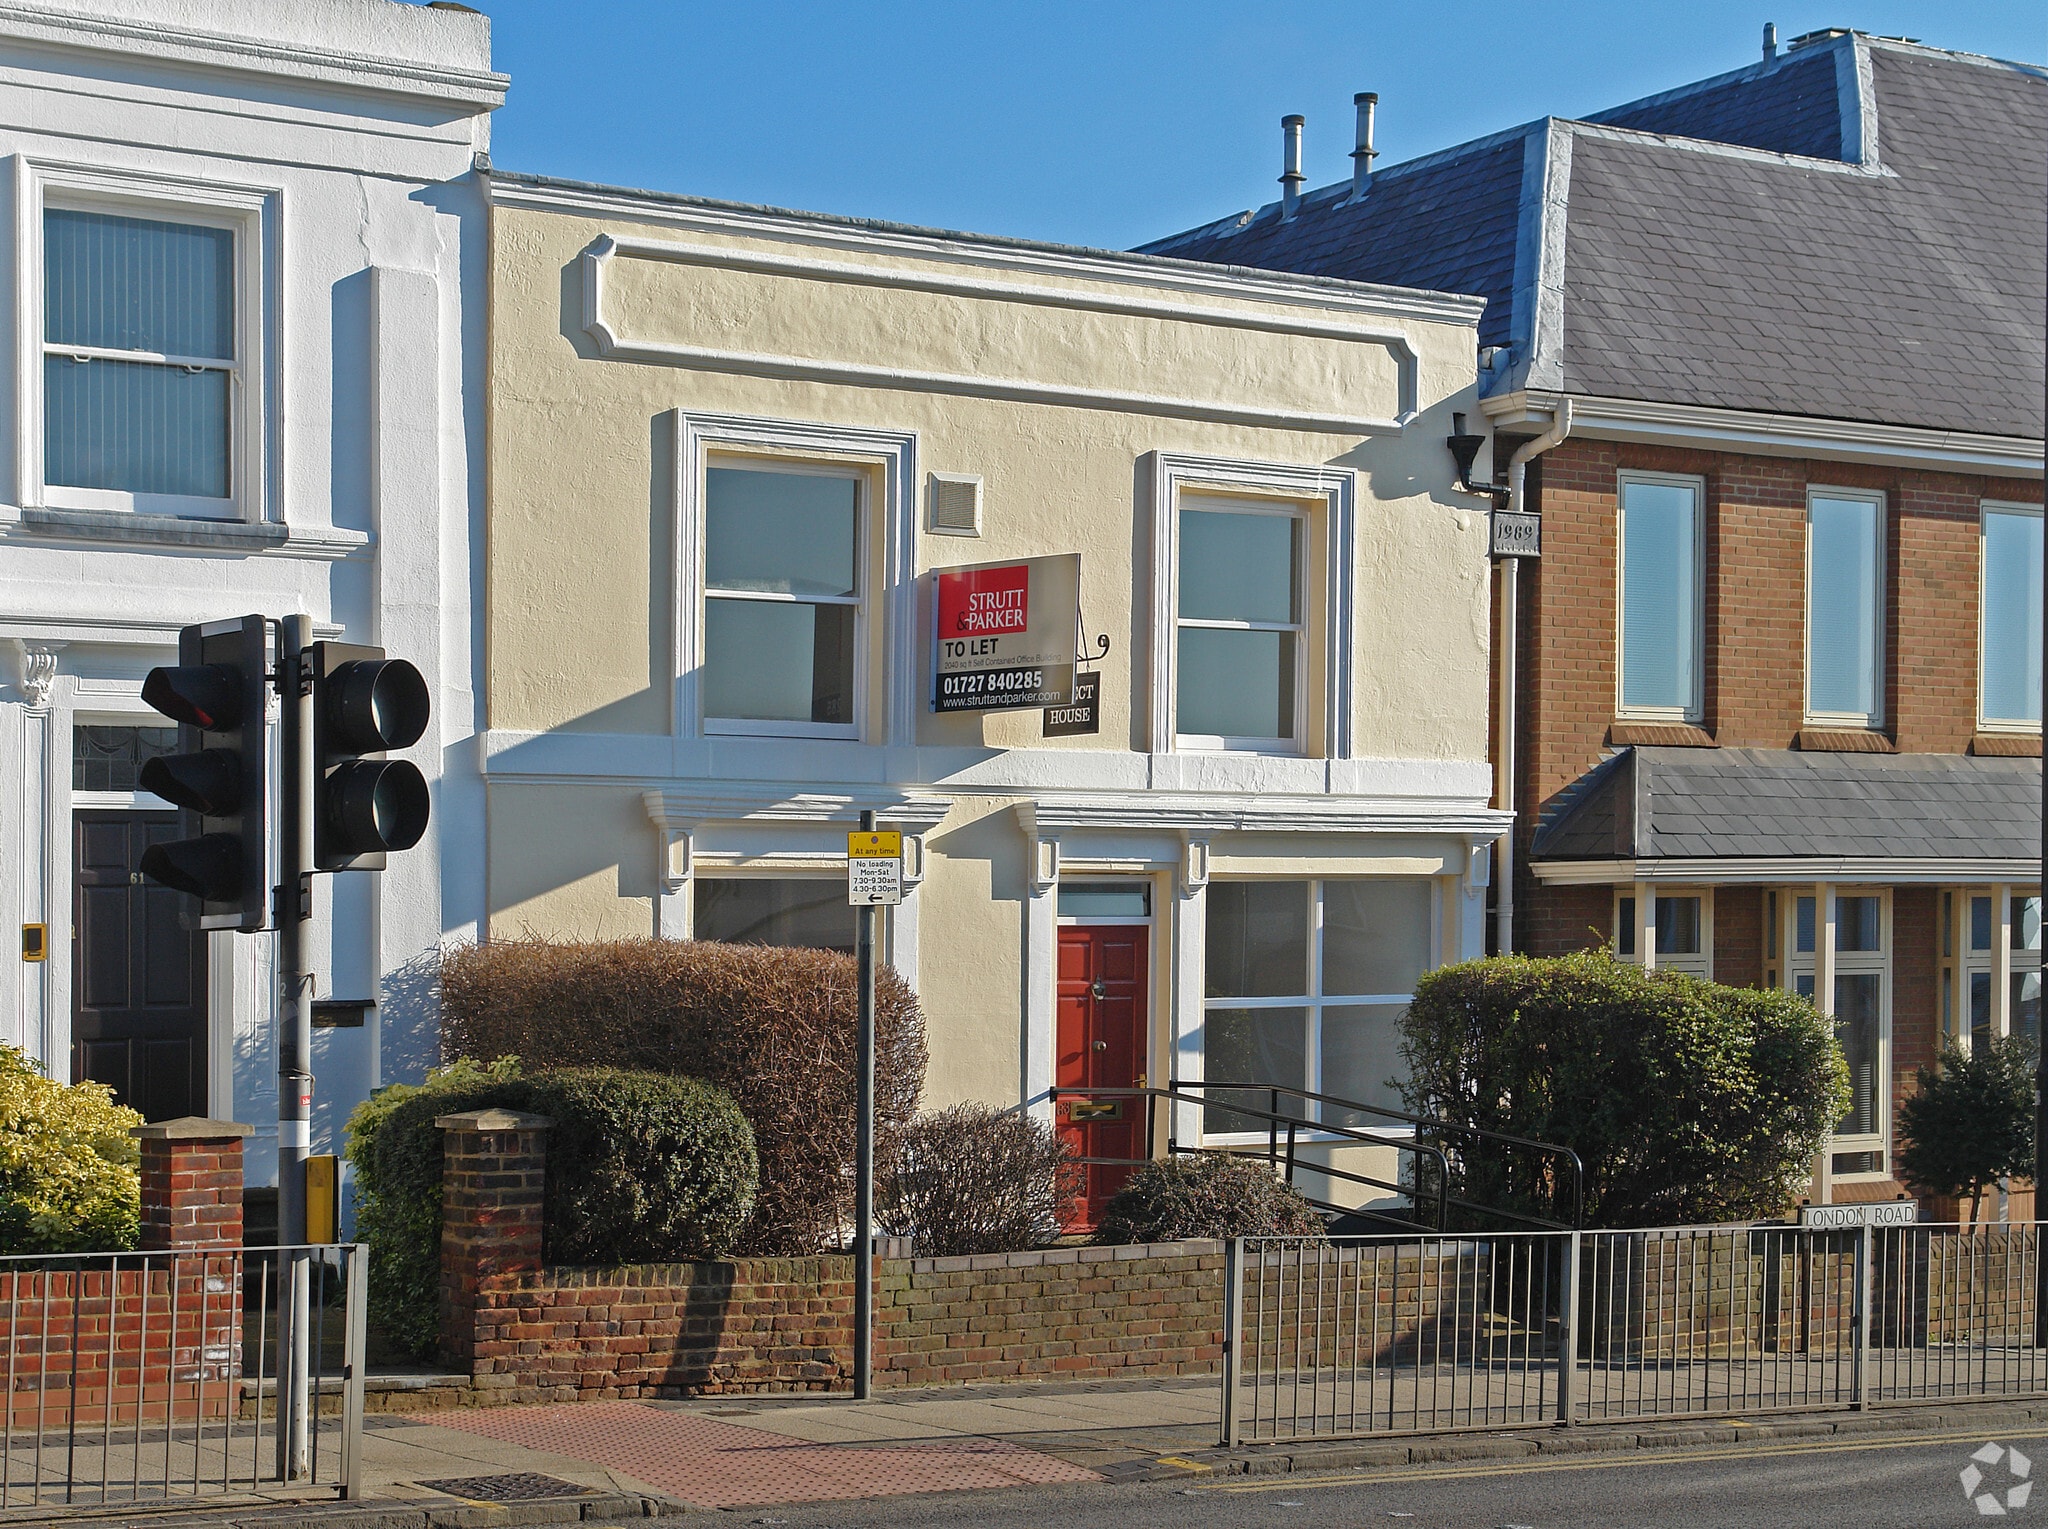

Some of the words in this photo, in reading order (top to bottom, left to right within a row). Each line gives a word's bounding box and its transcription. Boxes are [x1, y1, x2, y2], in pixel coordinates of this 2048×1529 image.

[1498, 523, 1533, 540] 1989
[969, 589, 1024, 611] STRUTT
[945, 640, 965, 657] TO
[970, 638, 998, 656] LET
[973, 658, 984, 667] Self
[985, 656, 1015, 666] Contained
[1016, 655, 1034, 664] Office
[944, 675, 985, 695] 01727
[987, 670, 1042, 691] 840285
[943, 690, 1060, 708] www.struttandparker.com
[1050, 707, 1090, 725] HOUSE
[130, 872, 145, 884] 61
[1806, 1208, 1866, 1226] LONDON
[1874, 1206, 1914, 1223] ROAD
